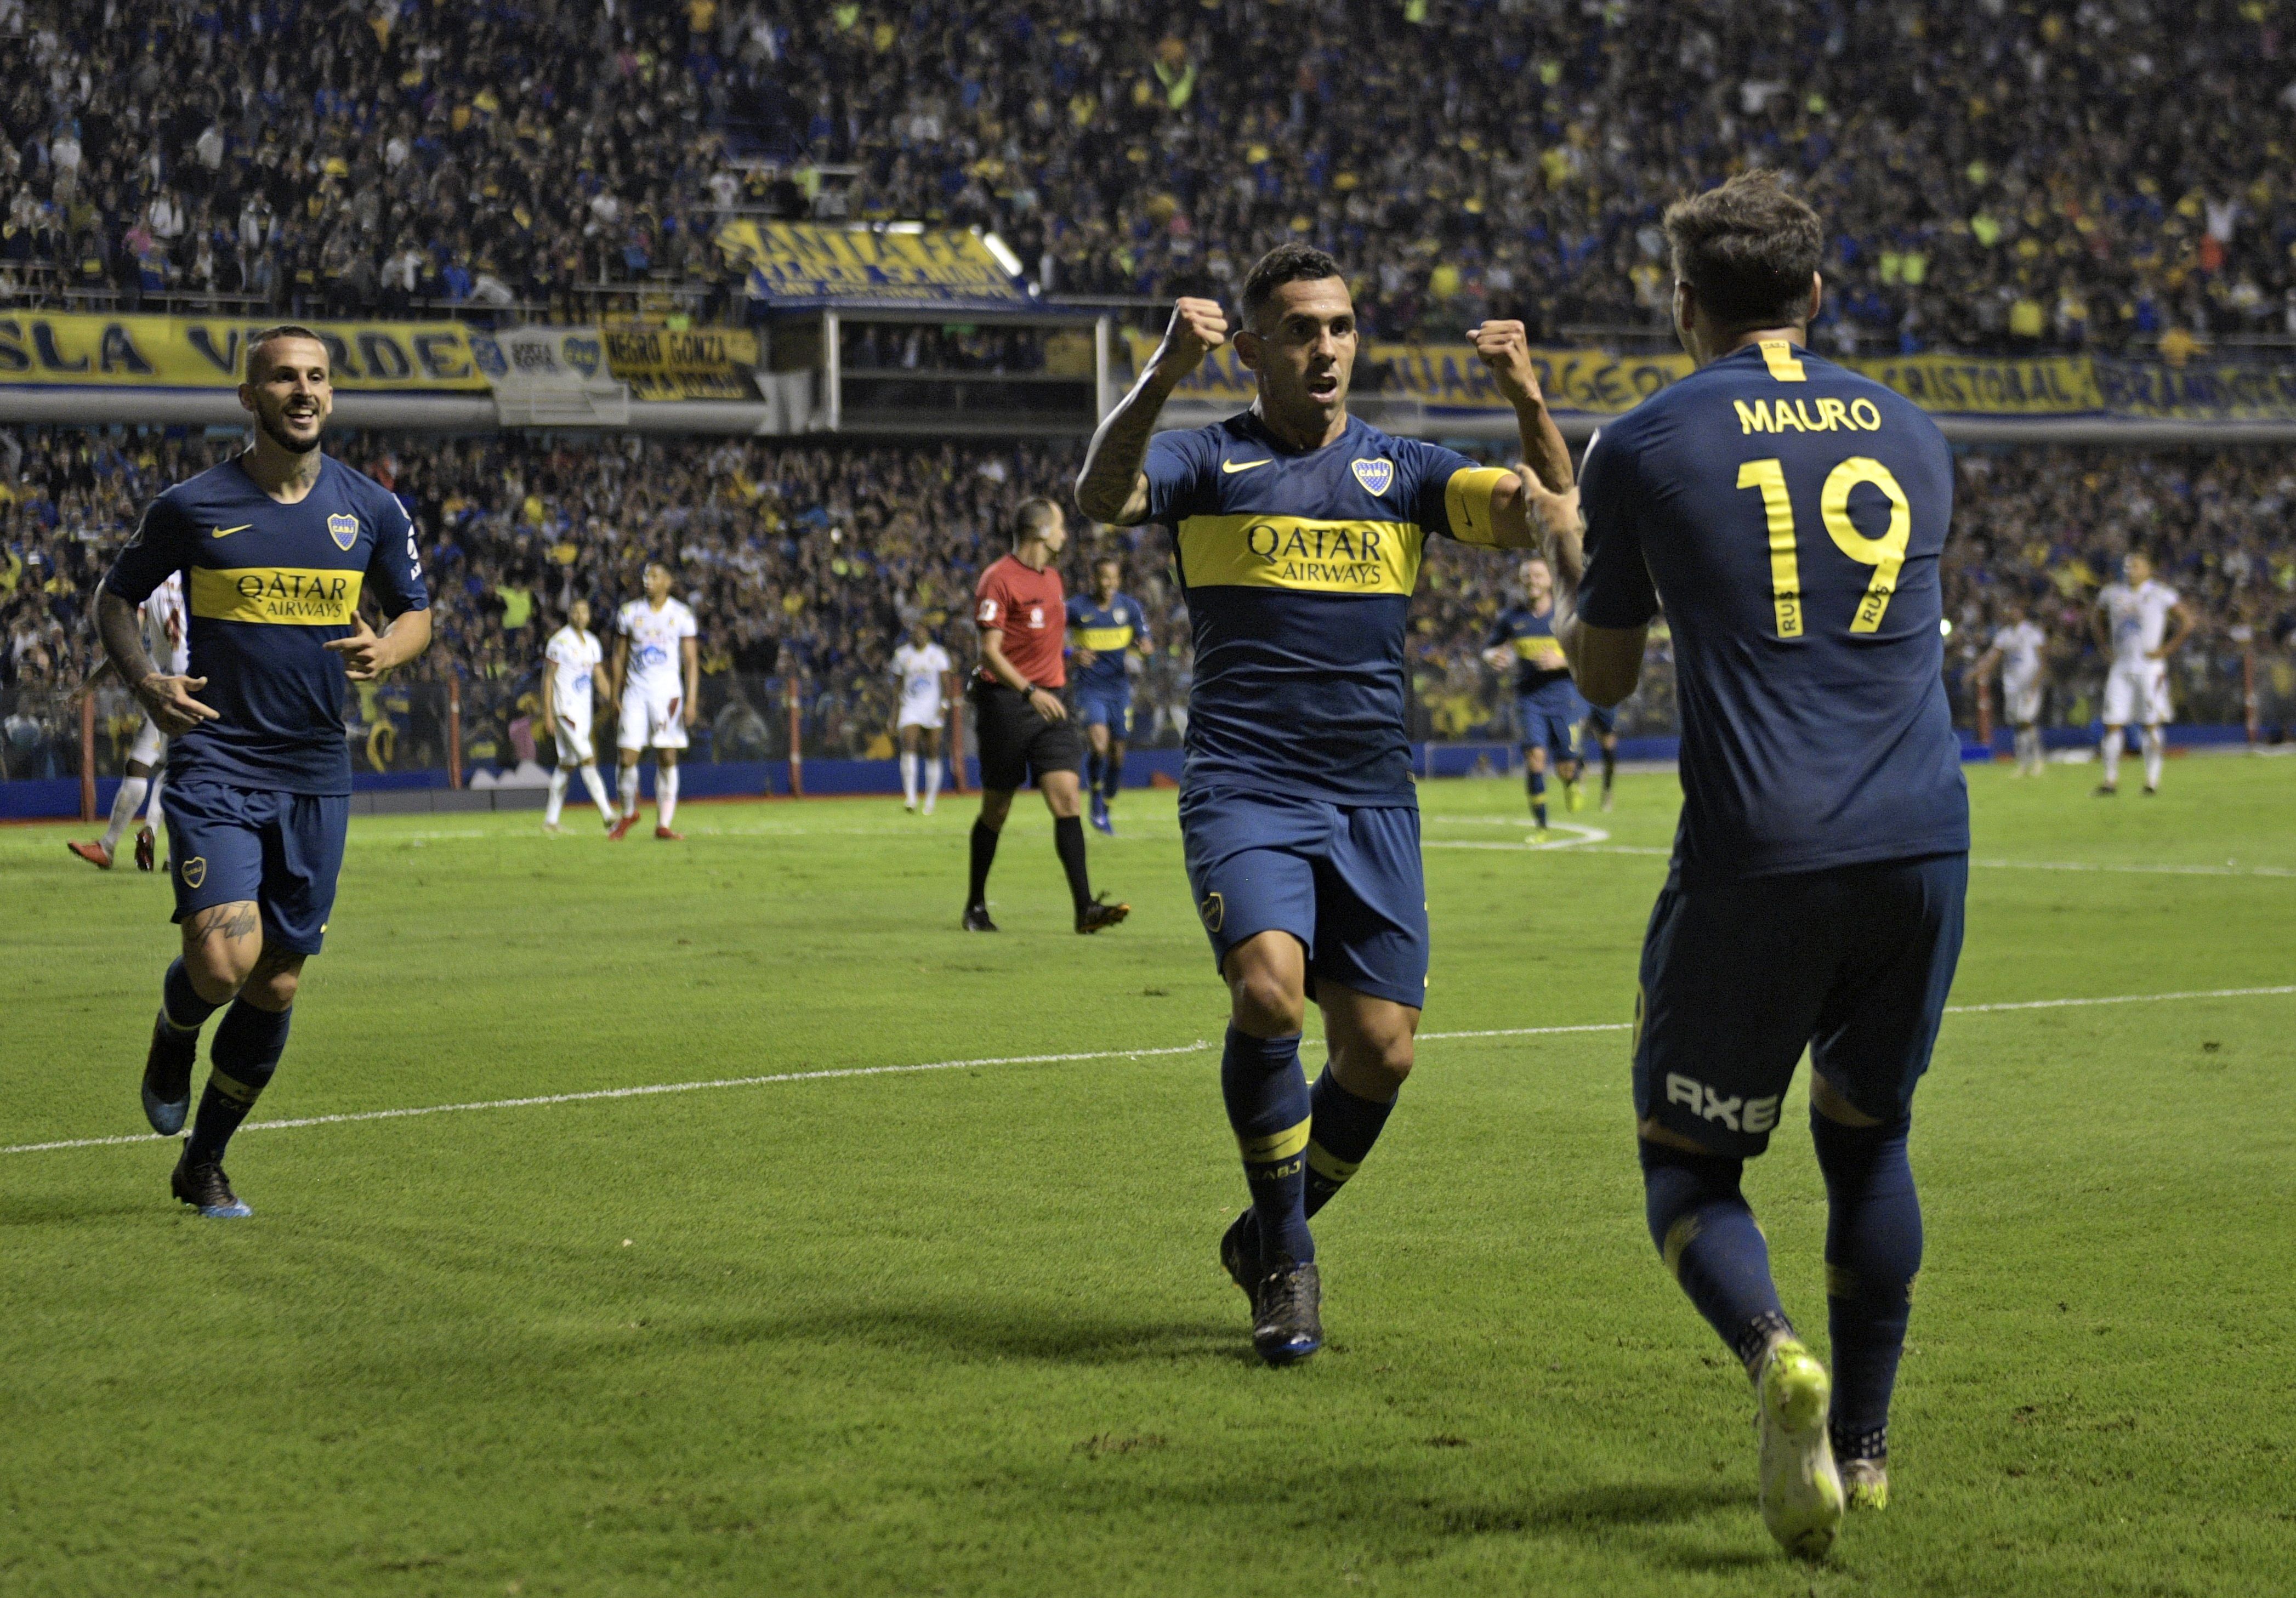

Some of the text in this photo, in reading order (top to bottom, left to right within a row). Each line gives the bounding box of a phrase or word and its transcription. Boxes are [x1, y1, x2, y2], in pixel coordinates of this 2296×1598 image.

[0, 320, 156, 375] SLA
[186, 326, 472, 379] VRDE
[1734, 397, 1882, 435] MAURO
[1248, 524, 1381, 564] QATAR
[1736, 456, 1911, 638] 19
[237, 572, 347, 602] QATAR
[1282, 560, 1380, 585] AIRWAYS
[265, 600, 343, 618] AIRWAYS
[1666, 1071, 1778, 1134] AXE
